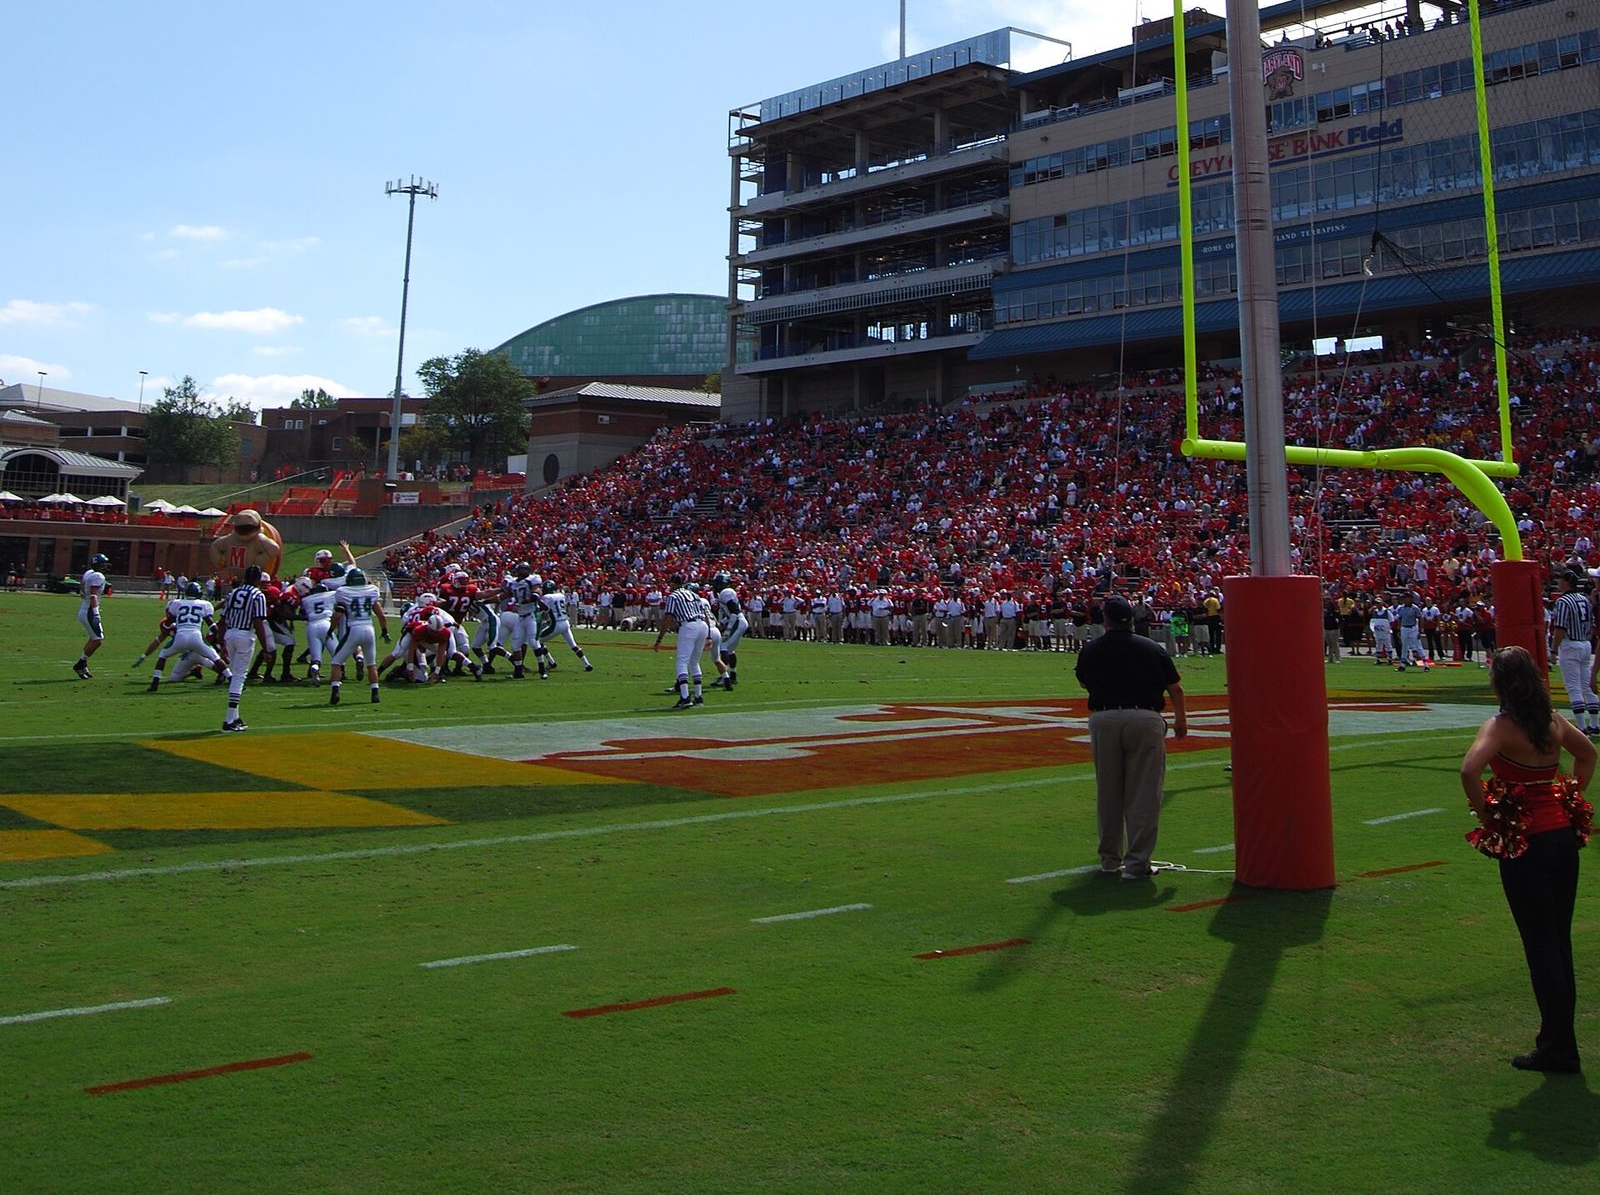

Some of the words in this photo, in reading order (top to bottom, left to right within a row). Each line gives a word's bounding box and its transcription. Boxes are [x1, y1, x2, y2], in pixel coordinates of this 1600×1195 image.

[1263, 54, 1303, 85] ARYLAND
[1168, 155, 1225, 181] CEVY
[1292, 130, 1344, 155] BANK
[1347, 118, 1403, 144] Field
[230, 545, 247, 568] M
[234, 591, 247, 609] S
[314, 602, 324, 614] 5
[350, 596, 373, 617] 44
[449, 596, 471, 612] 72
[1040, 604, 1047, 613] 5
[178, 606, 203, 624] 25
[1578, 601, 1587, 621] F
